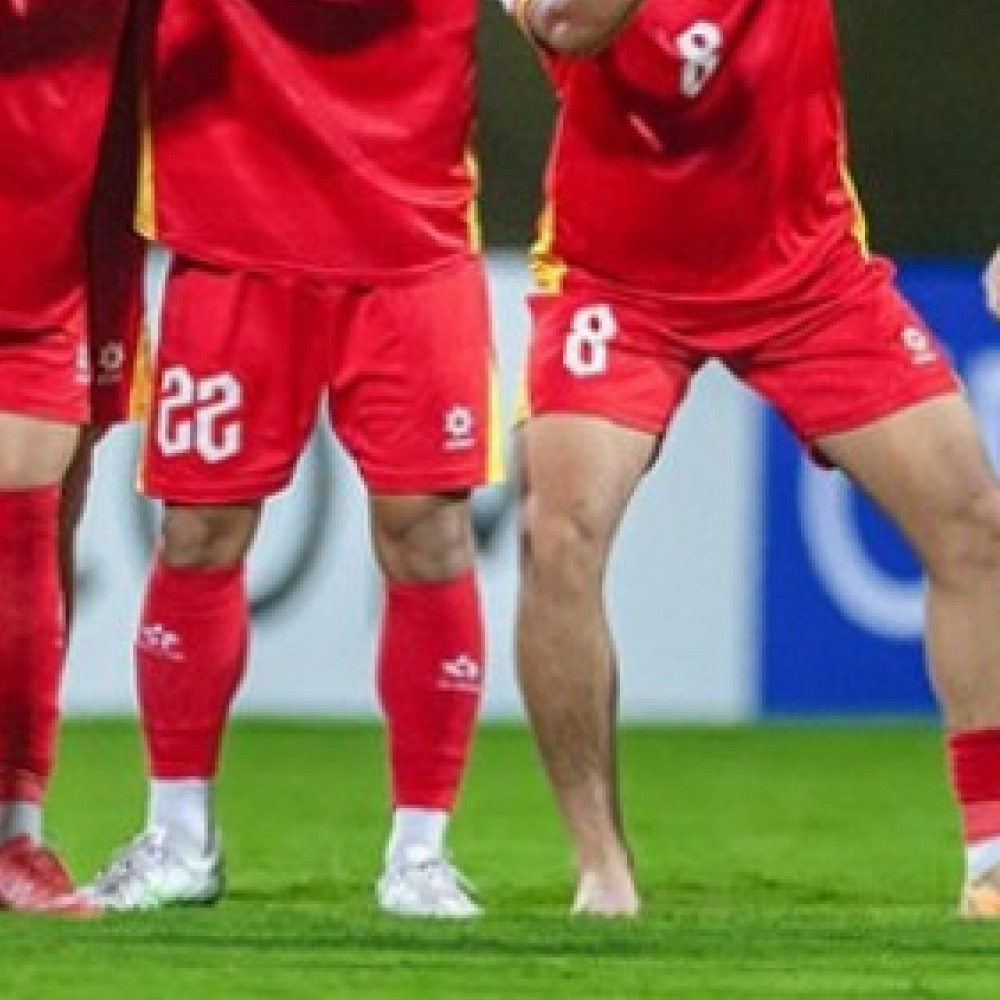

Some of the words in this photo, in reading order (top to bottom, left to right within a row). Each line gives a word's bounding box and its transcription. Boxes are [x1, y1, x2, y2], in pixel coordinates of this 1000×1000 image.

[676, 19, 722, 98] 8
[562, 303, 618, 377] 8
[157, 364, 243, 464] 22
